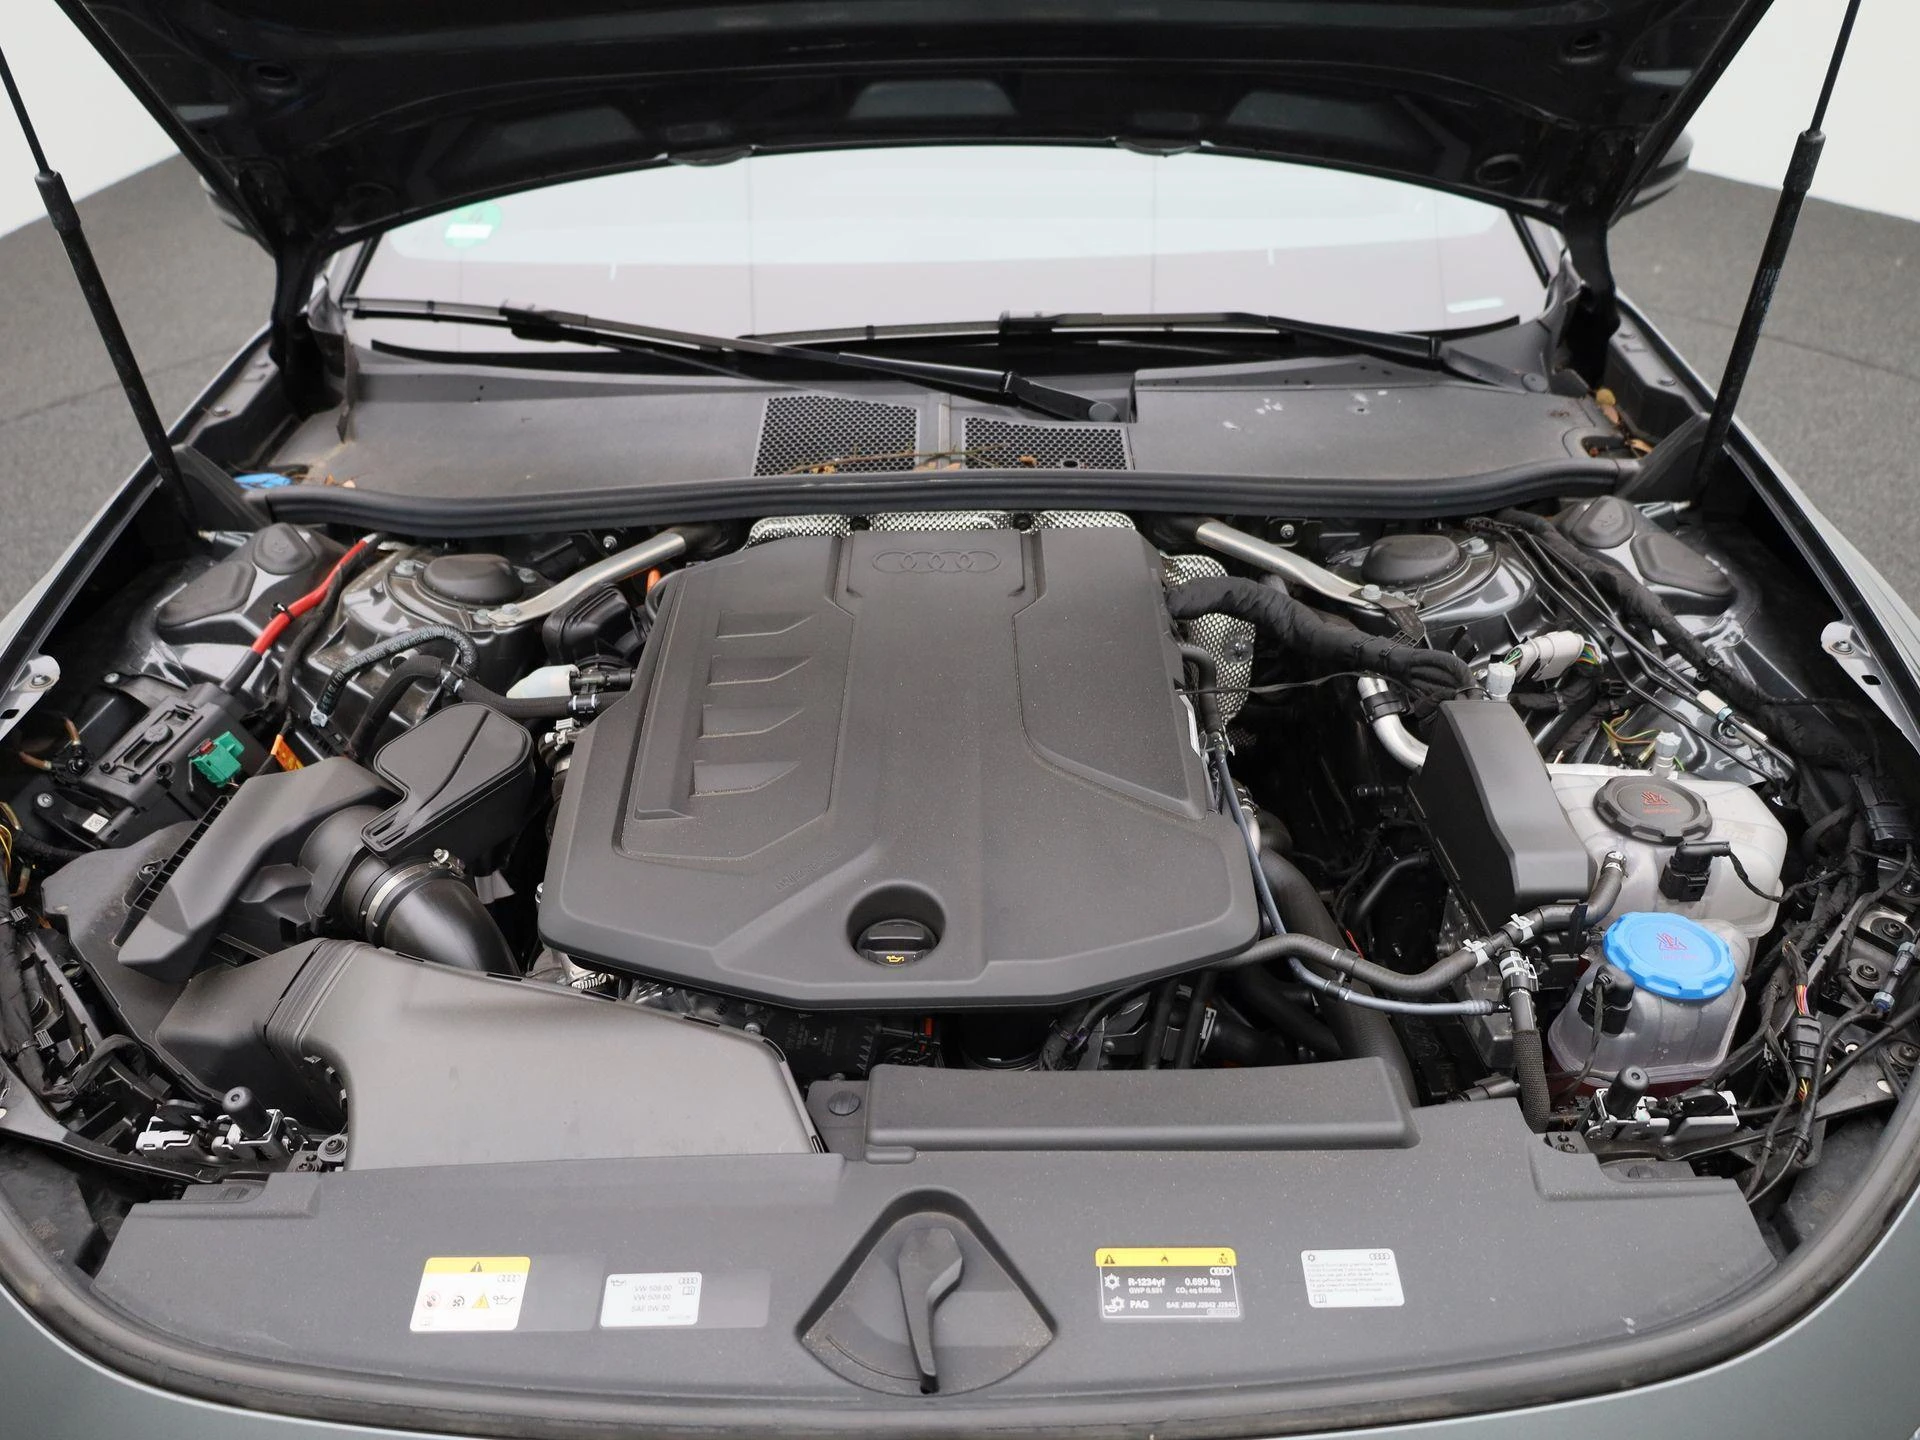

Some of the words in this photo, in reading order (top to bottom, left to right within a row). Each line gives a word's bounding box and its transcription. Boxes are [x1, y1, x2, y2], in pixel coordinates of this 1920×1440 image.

[1128, 1277, 1165, 1288] R-1234yf
[1210, 1277, 1221, 1287] kg
[1129, 1300, 1150, 1309] PAG
